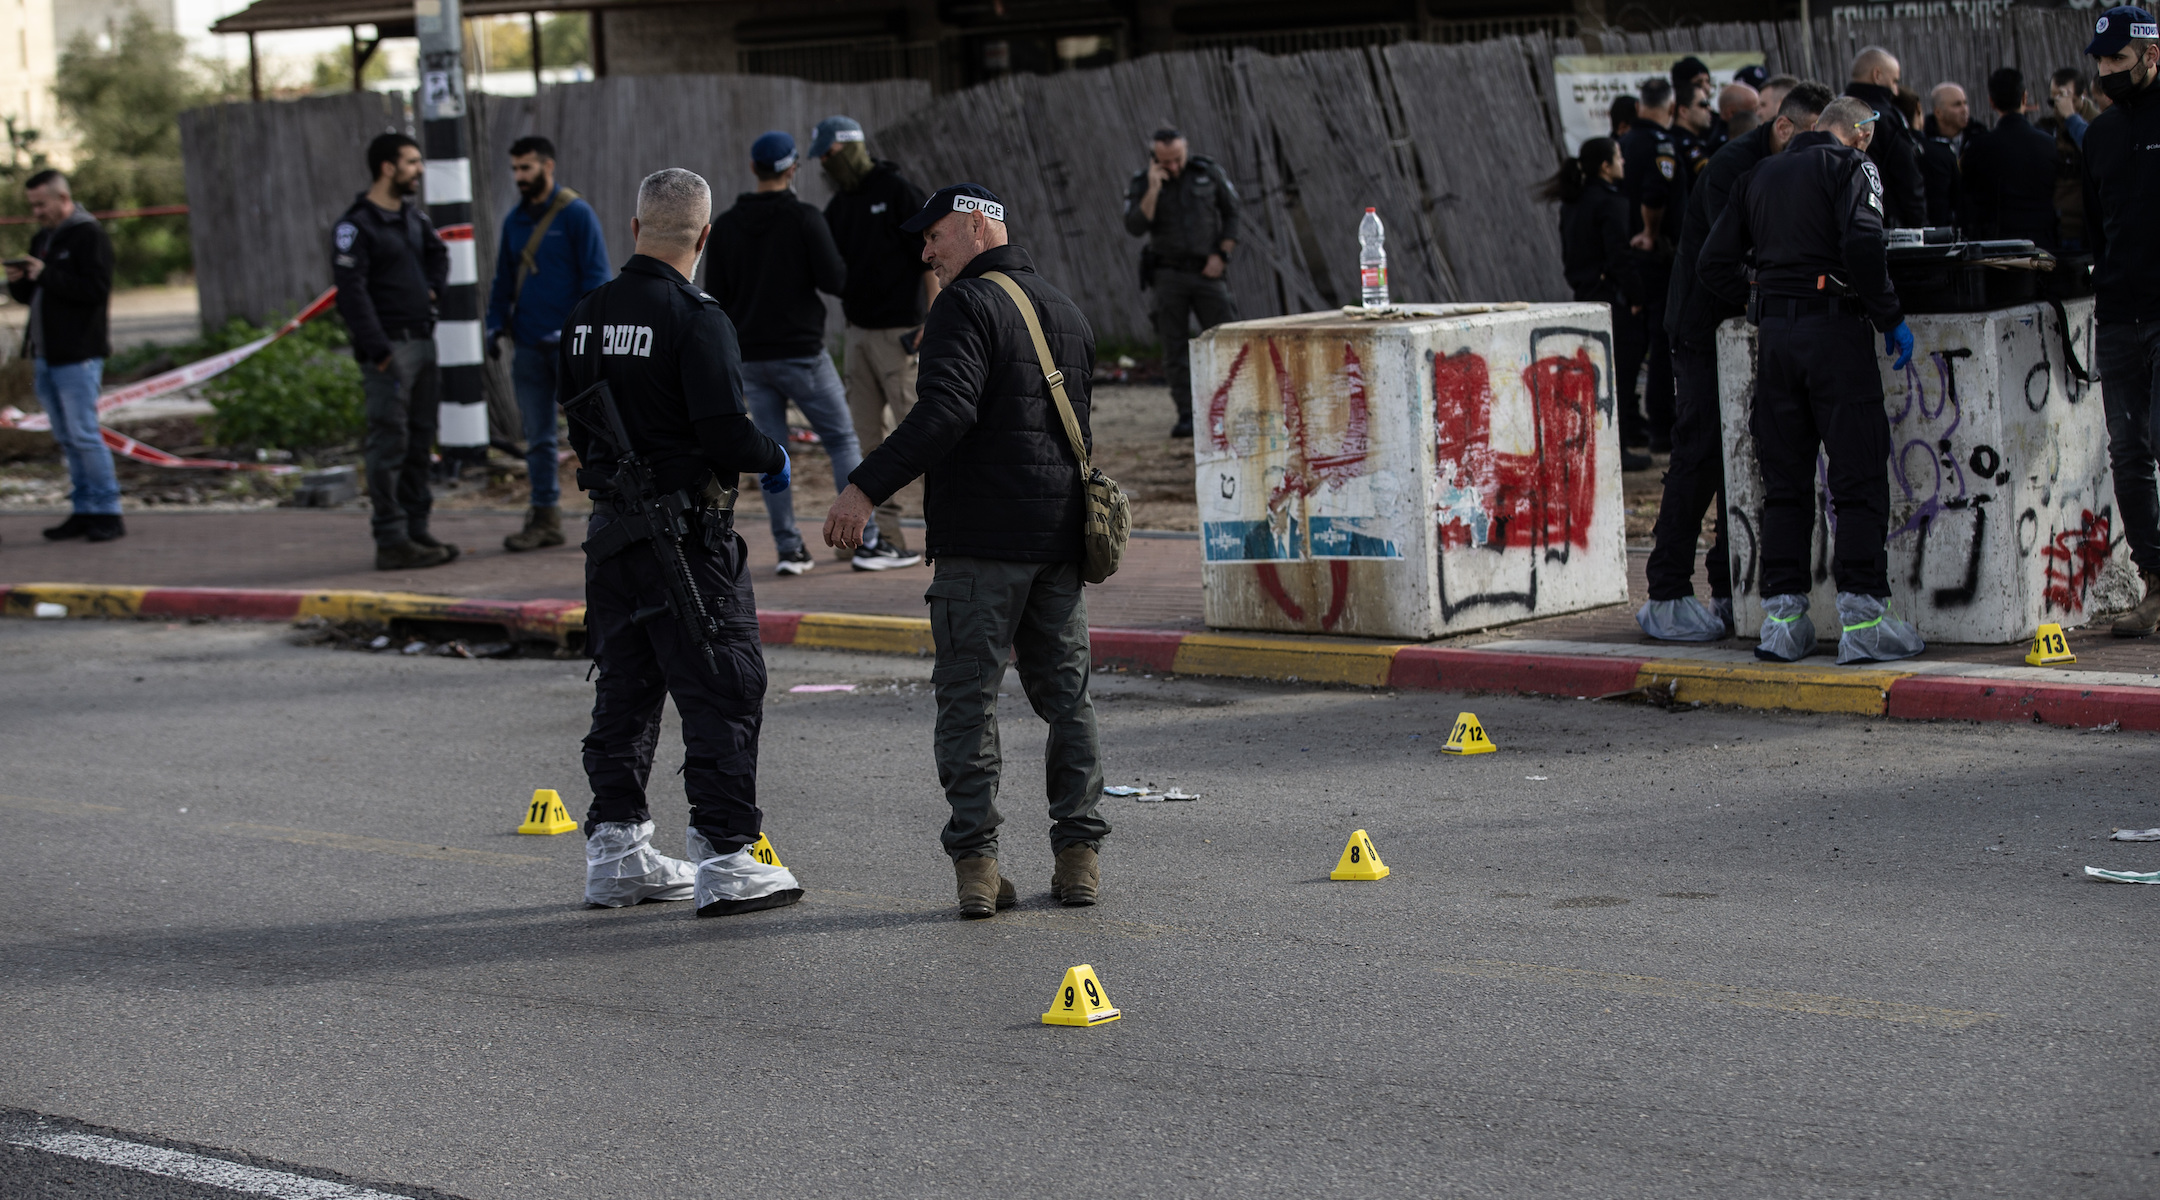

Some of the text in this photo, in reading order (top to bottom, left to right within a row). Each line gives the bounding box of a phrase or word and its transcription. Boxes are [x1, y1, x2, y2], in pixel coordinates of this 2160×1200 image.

[957, 198, 1003, 218] POLICE
[573, 324, 653, 357] משטה
[2042, 633, 2065, 654] 13
[1452, 722, 1467, 743] 12
[1469, 726, 1483, 742] 12
[530, 801, 548, 823] 11
[554, 806, 564, 821] 11
[758, 848, 773, 865] 10
[1351, 845, 1360, 864] 8
[1064, 986, 1075, 1007] 9
[1084, 978, 1100, 1007] 9
